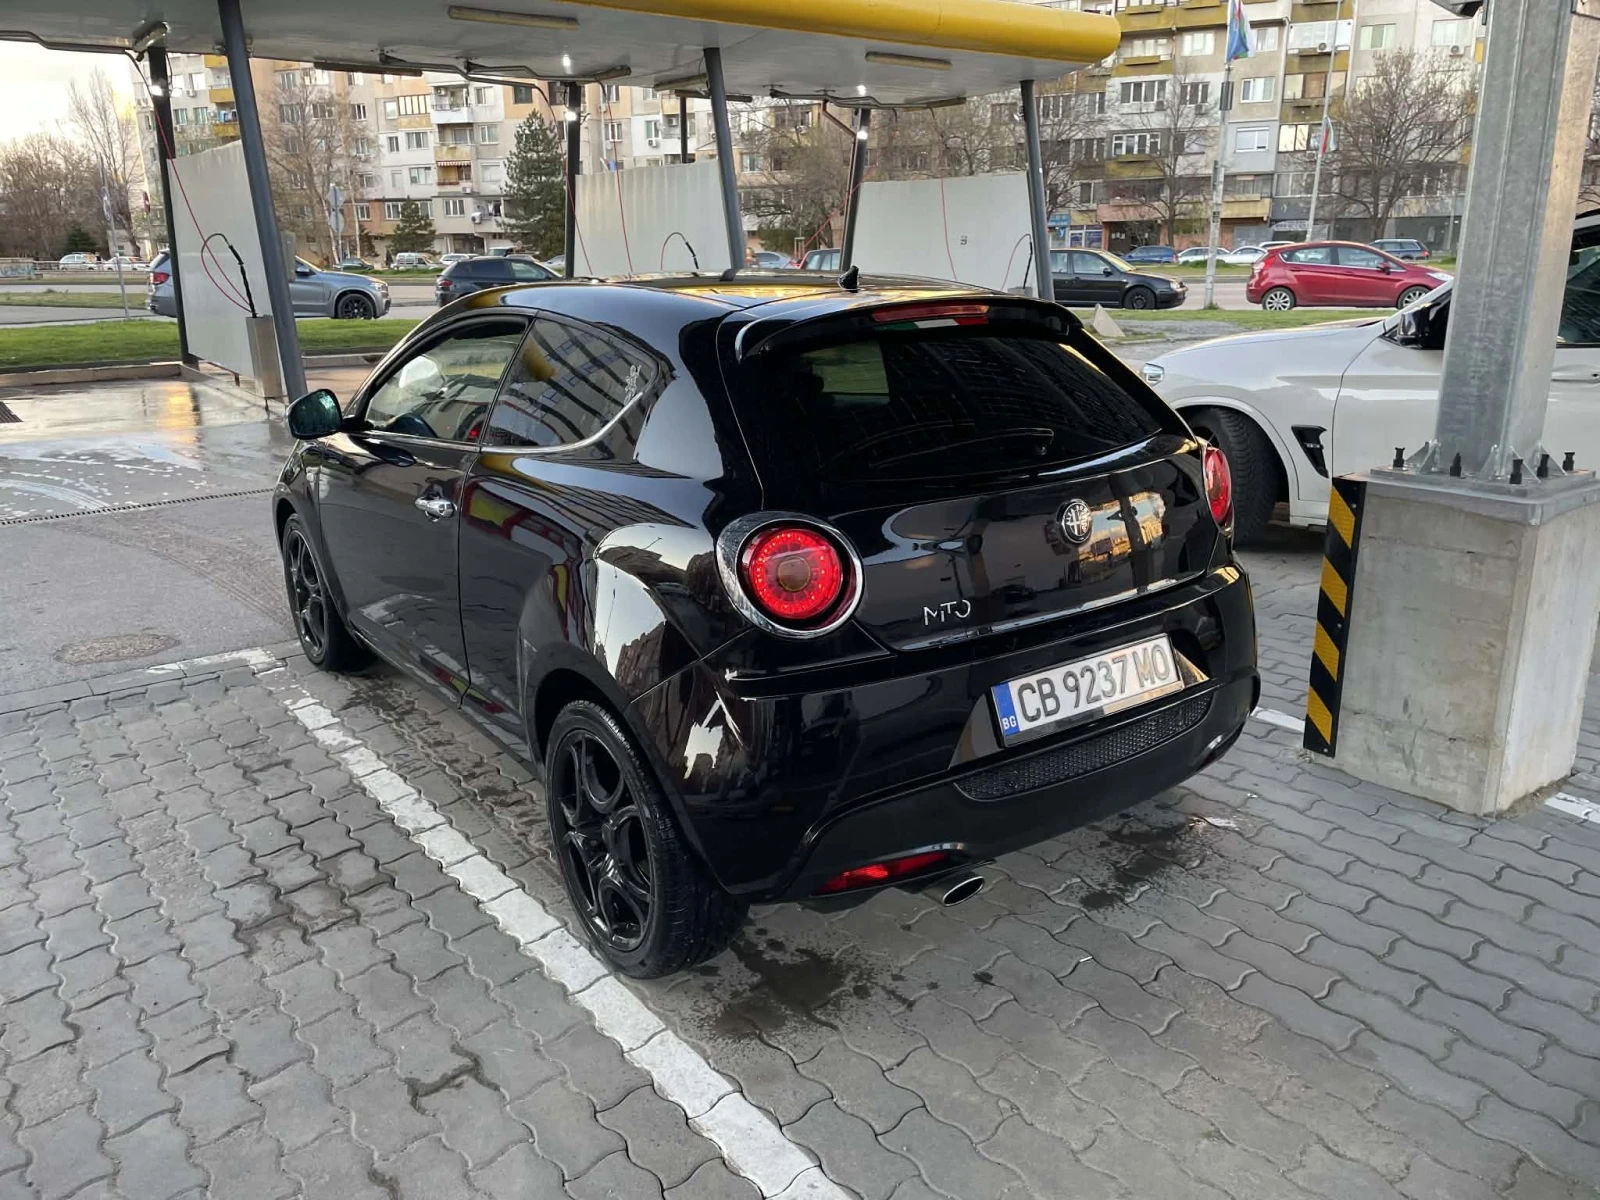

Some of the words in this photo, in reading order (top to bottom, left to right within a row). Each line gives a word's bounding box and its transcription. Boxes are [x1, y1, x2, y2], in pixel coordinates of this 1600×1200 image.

[1017, 677, 1061, 723] CB
[1062, 655, 1129, 709] 9237
[1132, 644, 1171, 689] MO
[1001, 715, 1017, 731] BG
